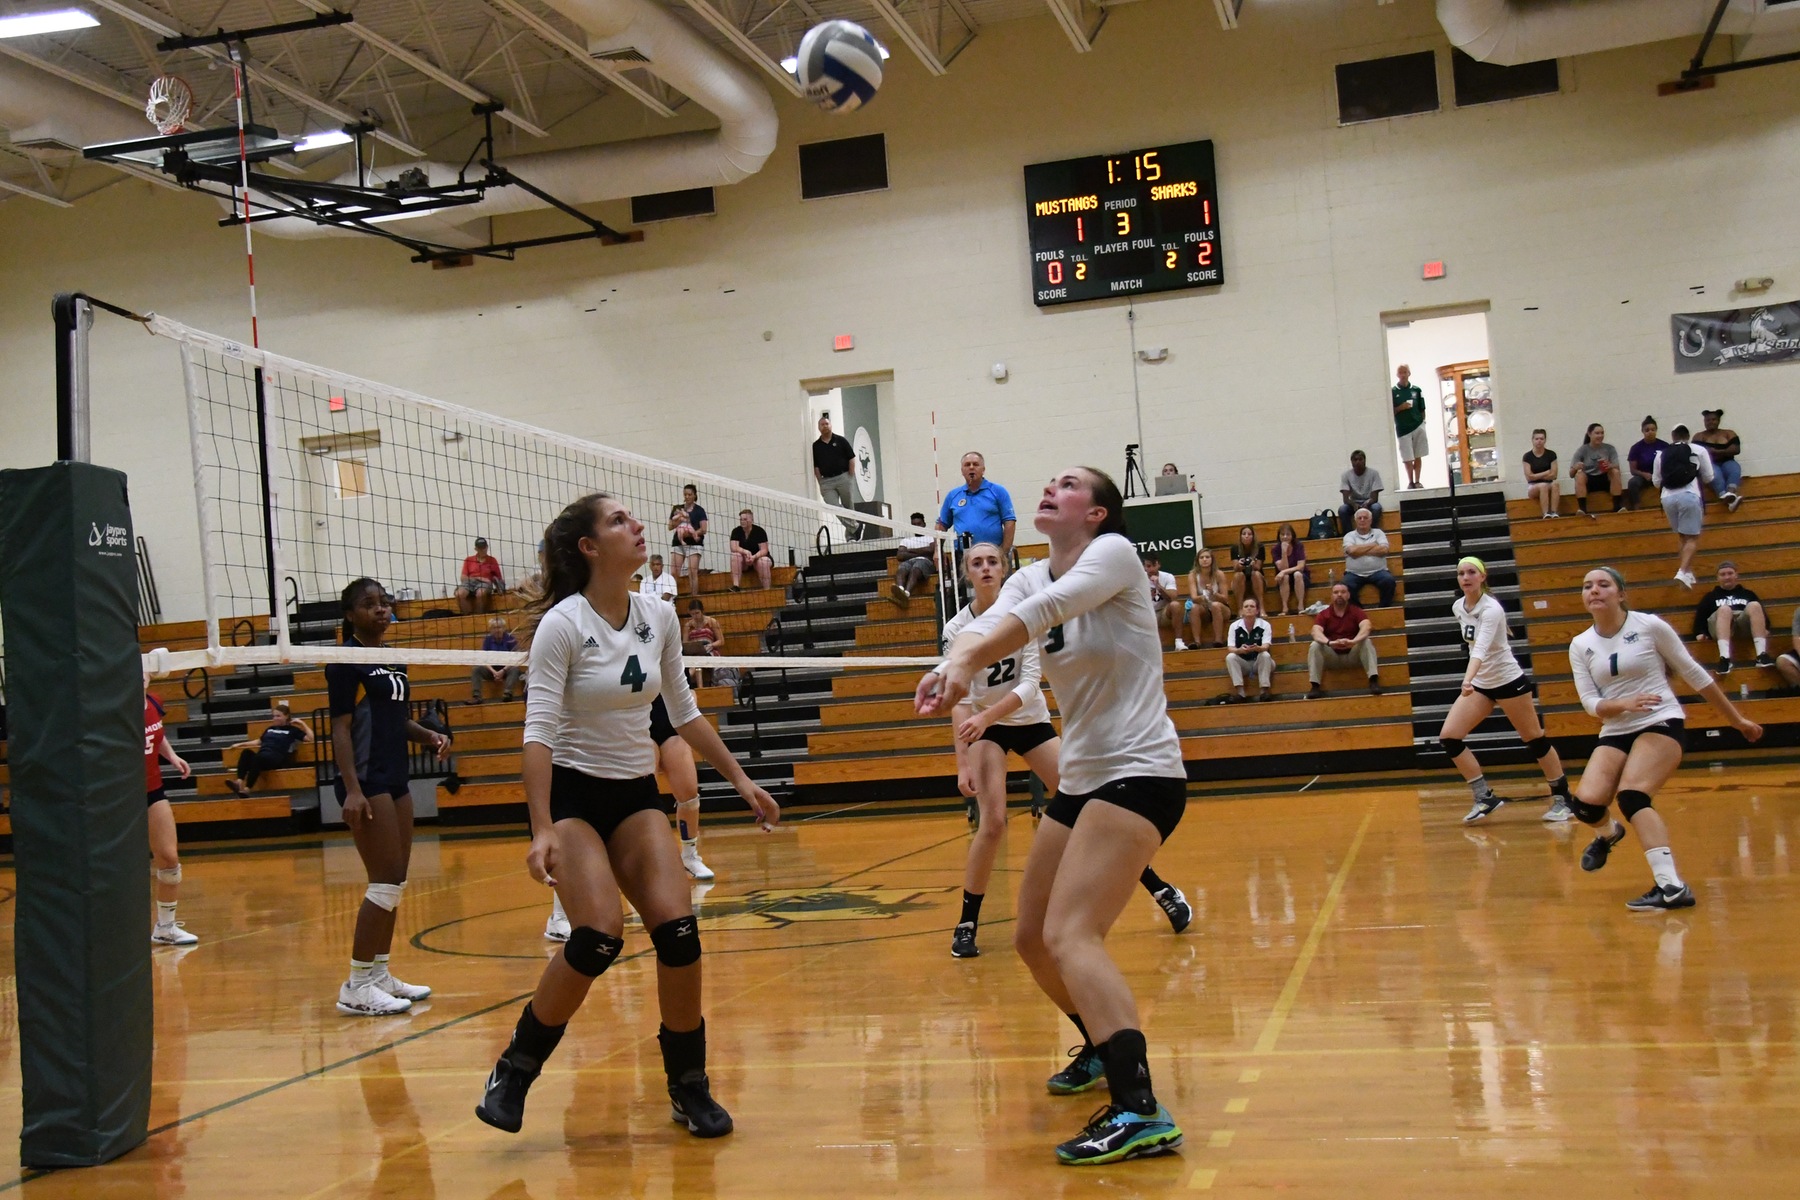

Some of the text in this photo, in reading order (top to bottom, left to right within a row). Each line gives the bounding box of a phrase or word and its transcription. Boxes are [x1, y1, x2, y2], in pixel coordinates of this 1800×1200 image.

[1151, 181, 1198, 201] SHARKS
[1035, 194, 1098, 217] MUSTANGS
[1104, 198, 1137, 211] PERIOD
[1203, 199, 1211, 225] 1
[1076, 216, 1084, 242] 1
[1116, 212, 1131, 236] 3
[1184, 230, 1214, 243] FOULS
[1035, 250, 1065, 262] FOULS
[1094, 238, 1156, 255] PLAYER FOUL
[1198, 242, 1212, 266] 2
[1165, 251, 1178, 269] 2
[1047, 261, 1063, 285] 0
[1075, 263, 1087, 280] 2
[1187, 270, 1217, 282] SCORE
[1038, 288, 1067, 300] SCORE
[1110, 279, 1143, 291] MATCH
[106, 536, 127, 547] sports
[1464, 625, 1476, 641] 13
[620, 654, 648, 693] 4
[987, 657, 1016, 688] 22
[1608, 652, 1619, 677] 1
[388, 673, 405, 701] 11
